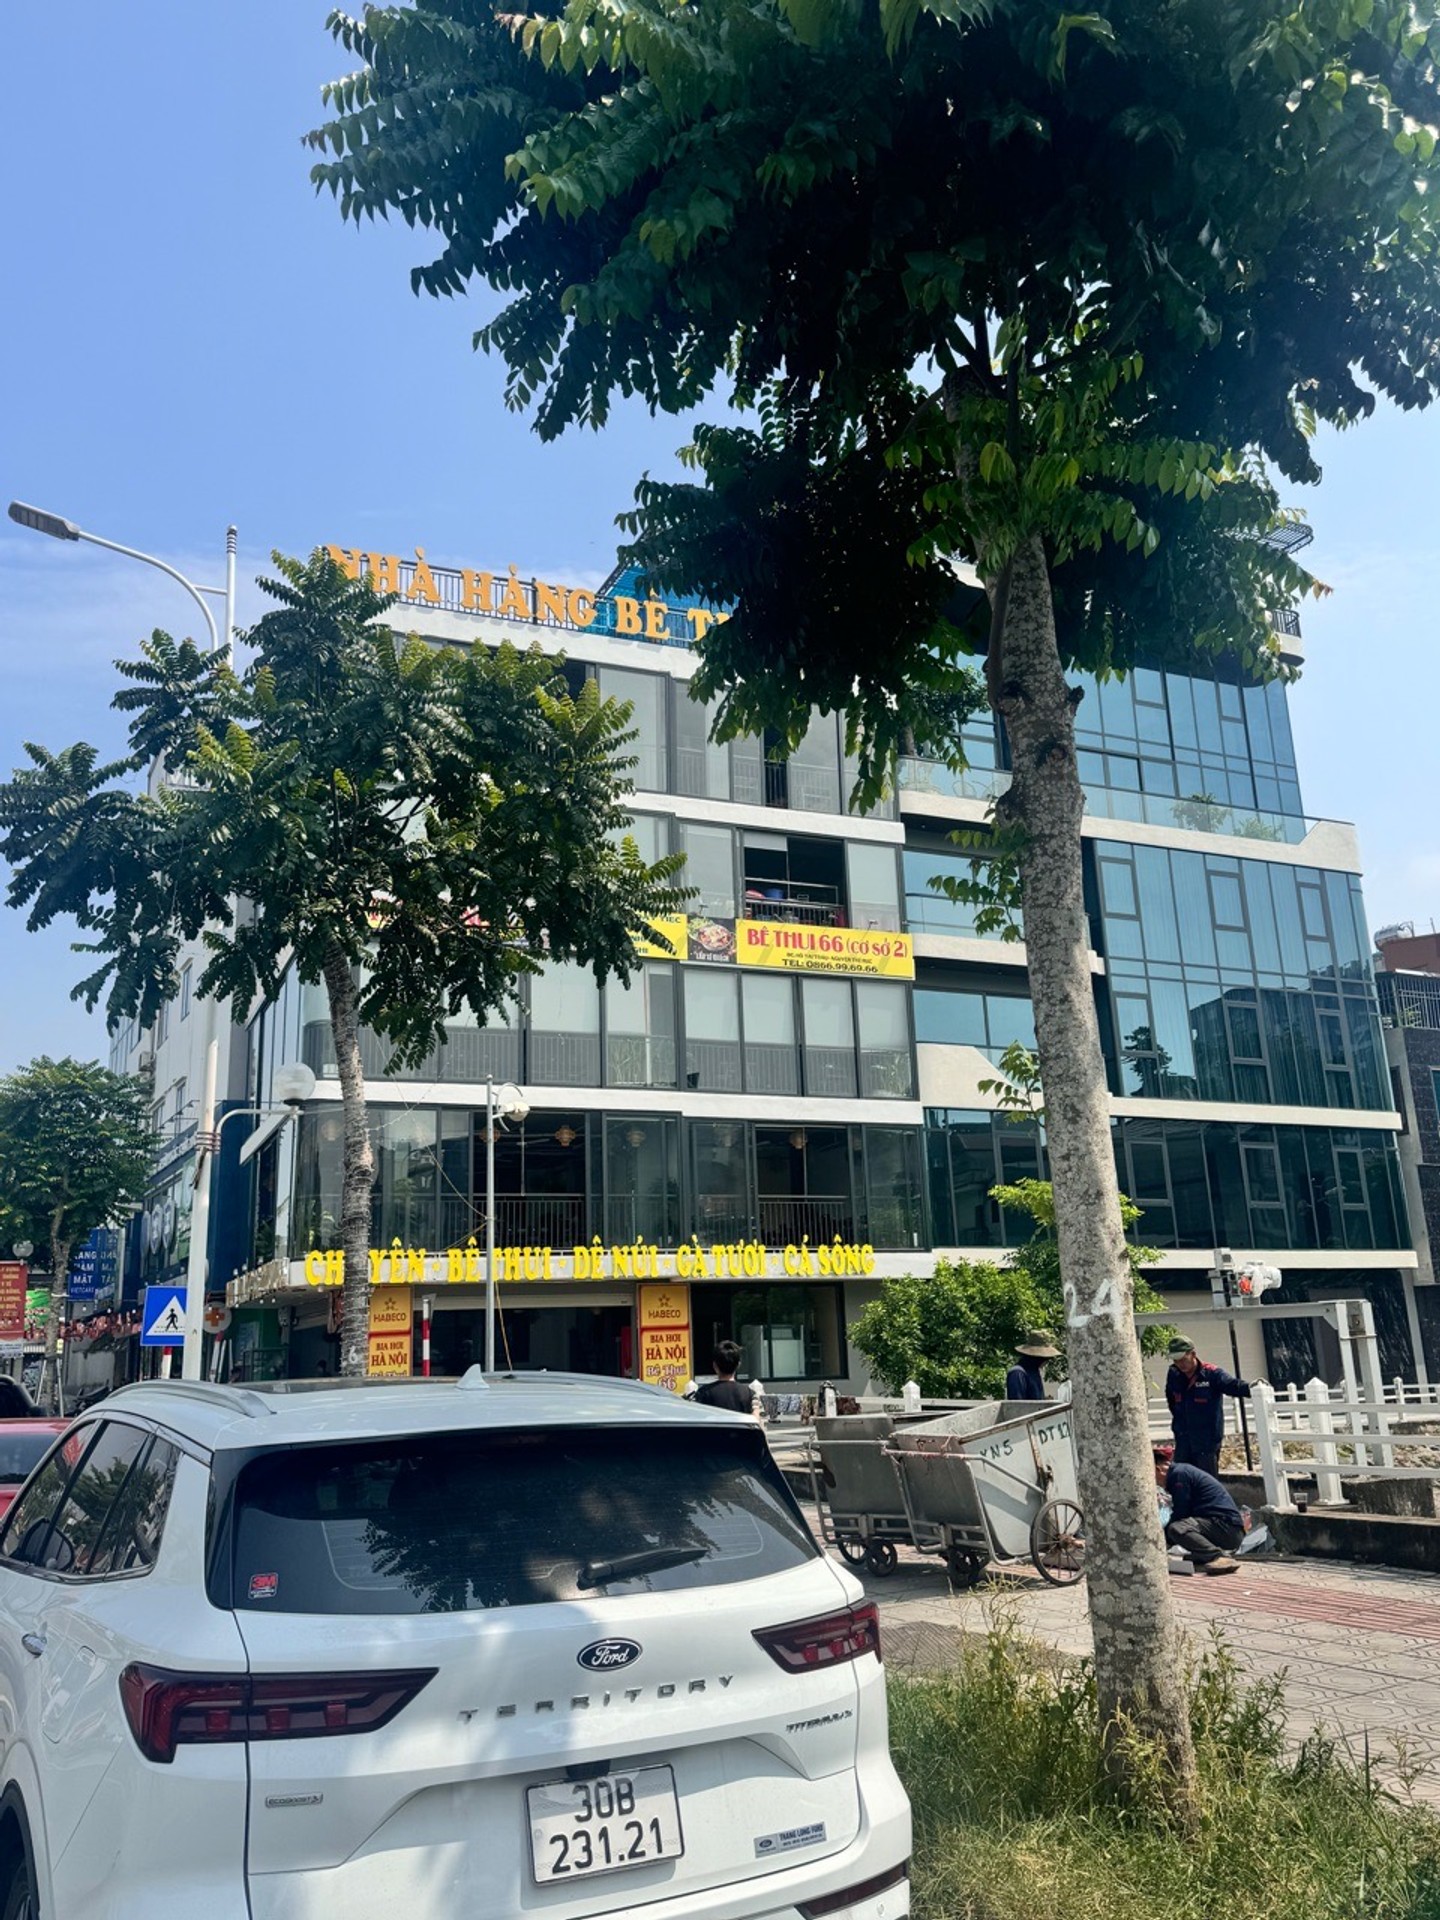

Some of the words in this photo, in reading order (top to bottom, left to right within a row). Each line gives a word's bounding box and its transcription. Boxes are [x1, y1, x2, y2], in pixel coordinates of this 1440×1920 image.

[463, 564, 597, 628] HÀNG
[747, 926, 770, 947] BÊ
[773, 930, 815, 951] THUI
[819, 934, 844, 953] 66
[305, 1236, 426, 1287] CHYÊN
[447, 1236, 481, 1283] BÊ
[573, 1234, 605, 1281] DÊ
[612, 1235, 659, 1279] NÚI
[676, 1234, 710, 1278] GÀ
[711, 1238, 767, 1277] TƯƠI
[784, 1234, 813, 1276] CÁ
[817, 1234, 876, 1276] SÔNG
[373, 1312, 407, 1323] HABECO
[648, 1310, 681, 1319] HABECO
[376, 1342, 389, 1351] BIA
[650, 1334, 664, 1343] BIA
[371, 1352, 386, 1366] HÀ
[389, 1351, 408, 1367] NỘI
[645, 1345, 662, 1360] HÀ
[665, 1344, 687, 1362] NỘI
[658, 1376, 677, 1391] 66
[252, 1575, 277, 1589] 3M
[591, 1645, 630, 1666] Ford
[457, 1674, 734, 1725] TERRITORY
[572, 1777, 635, 1823] 30B
[549, 1817, 663, 1875] 231.21
